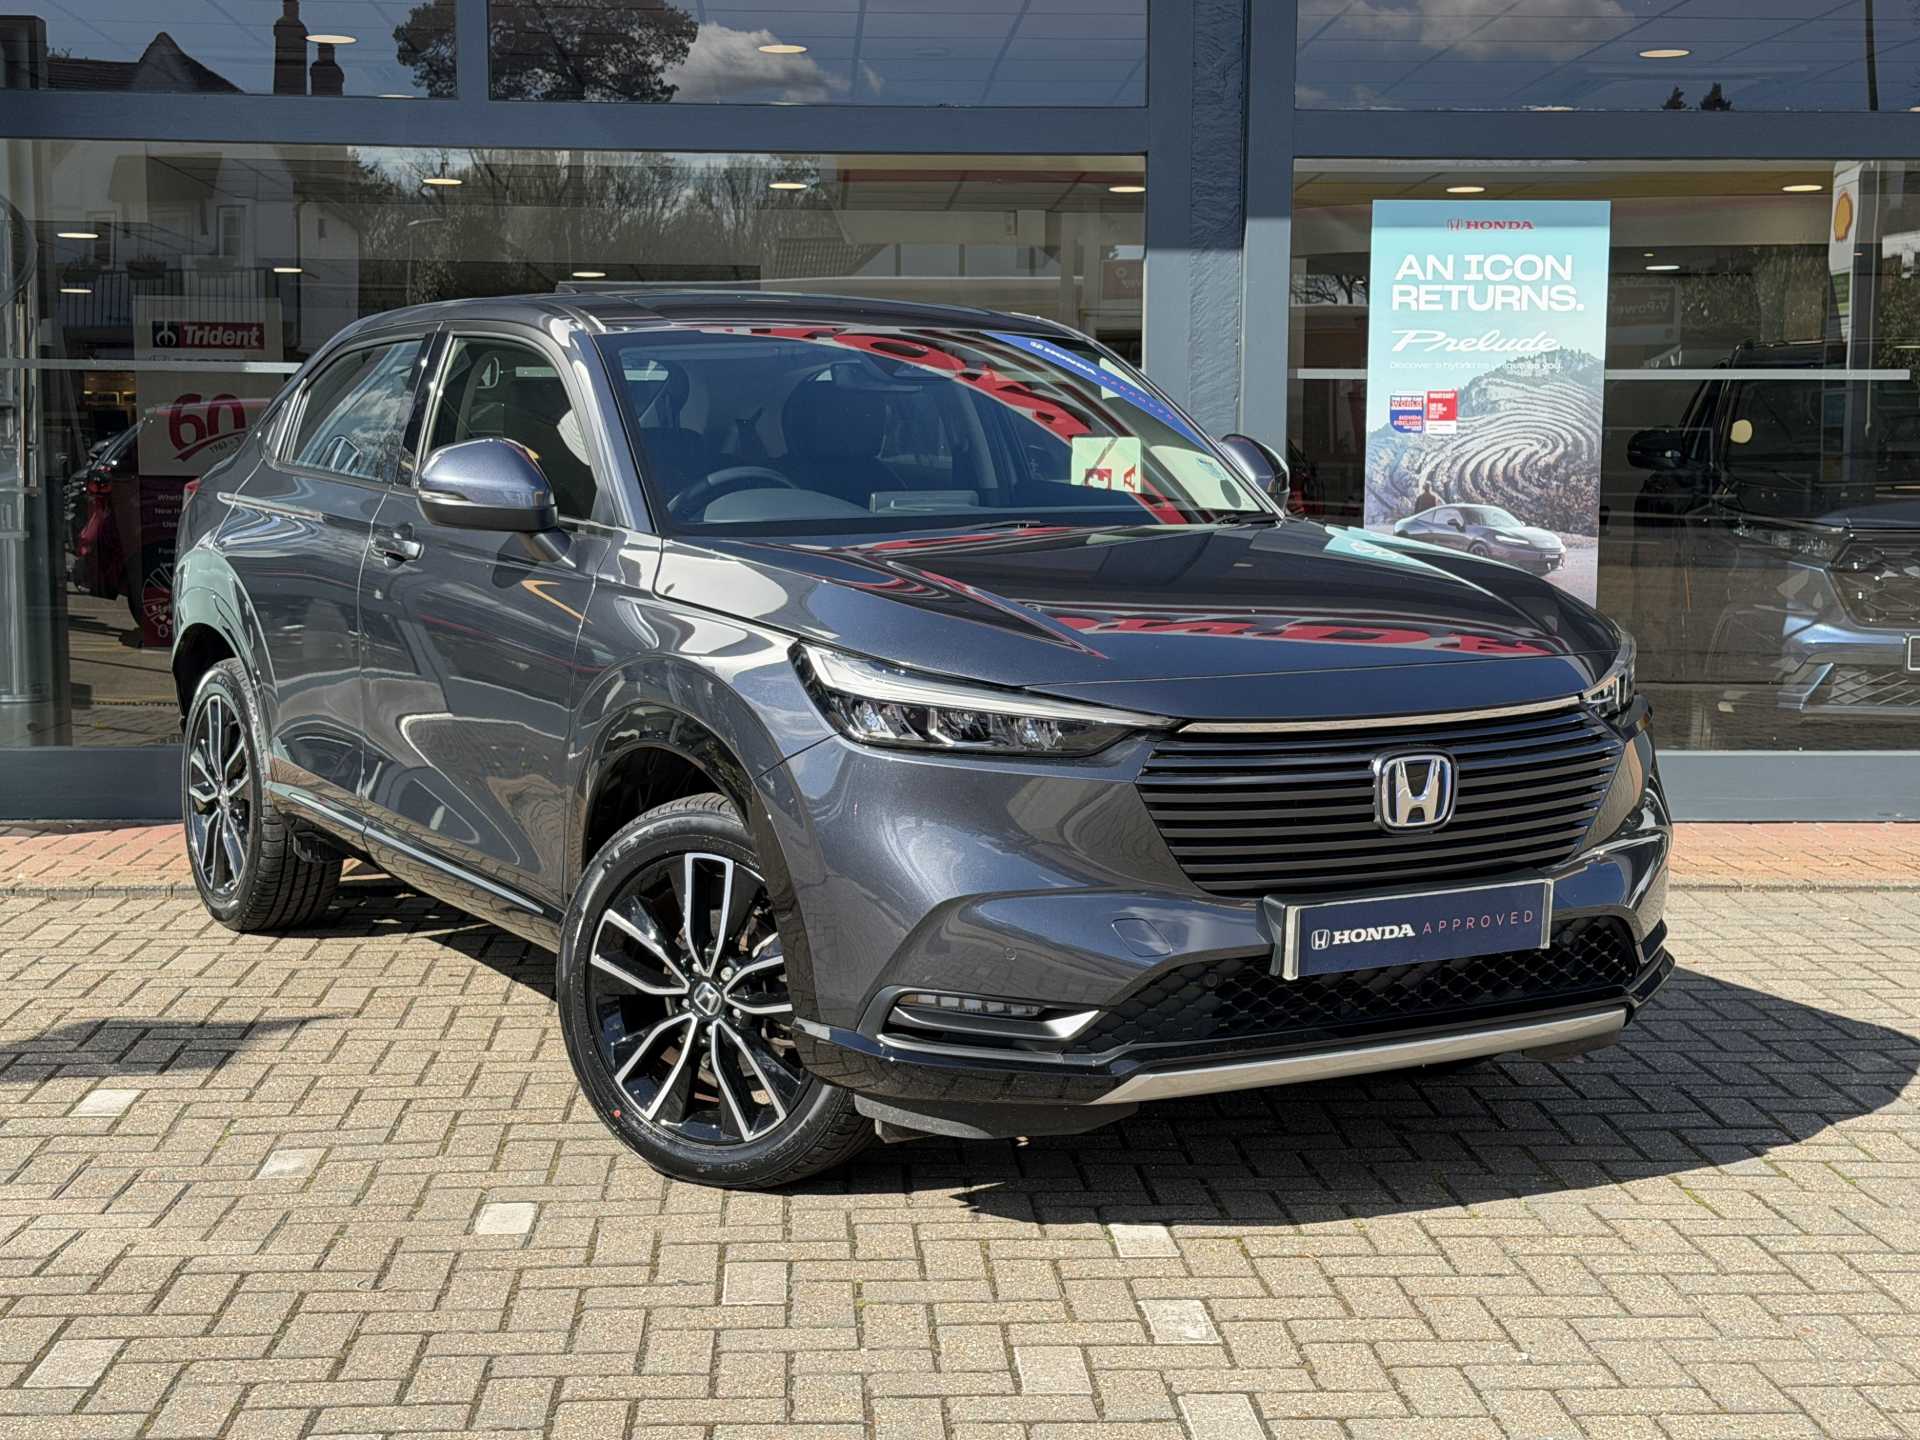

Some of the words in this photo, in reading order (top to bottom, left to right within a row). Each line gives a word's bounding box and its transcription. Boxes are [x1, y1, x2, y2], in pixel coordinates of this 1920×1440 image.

[1466, 220, 1534, 230] HONDA
[1394, 254, 1454, 281] AN
[1463, 254, 1573, 281] ICON
[1391, 284, 1585, 312] RETURNS.
[183, 325, 260, 347] Trident
[1391, 329, 1562, 352] Prelude
[1332, 923, 1416, 945] HONDA
[1422, 910, 1534, 936] APPROVED
